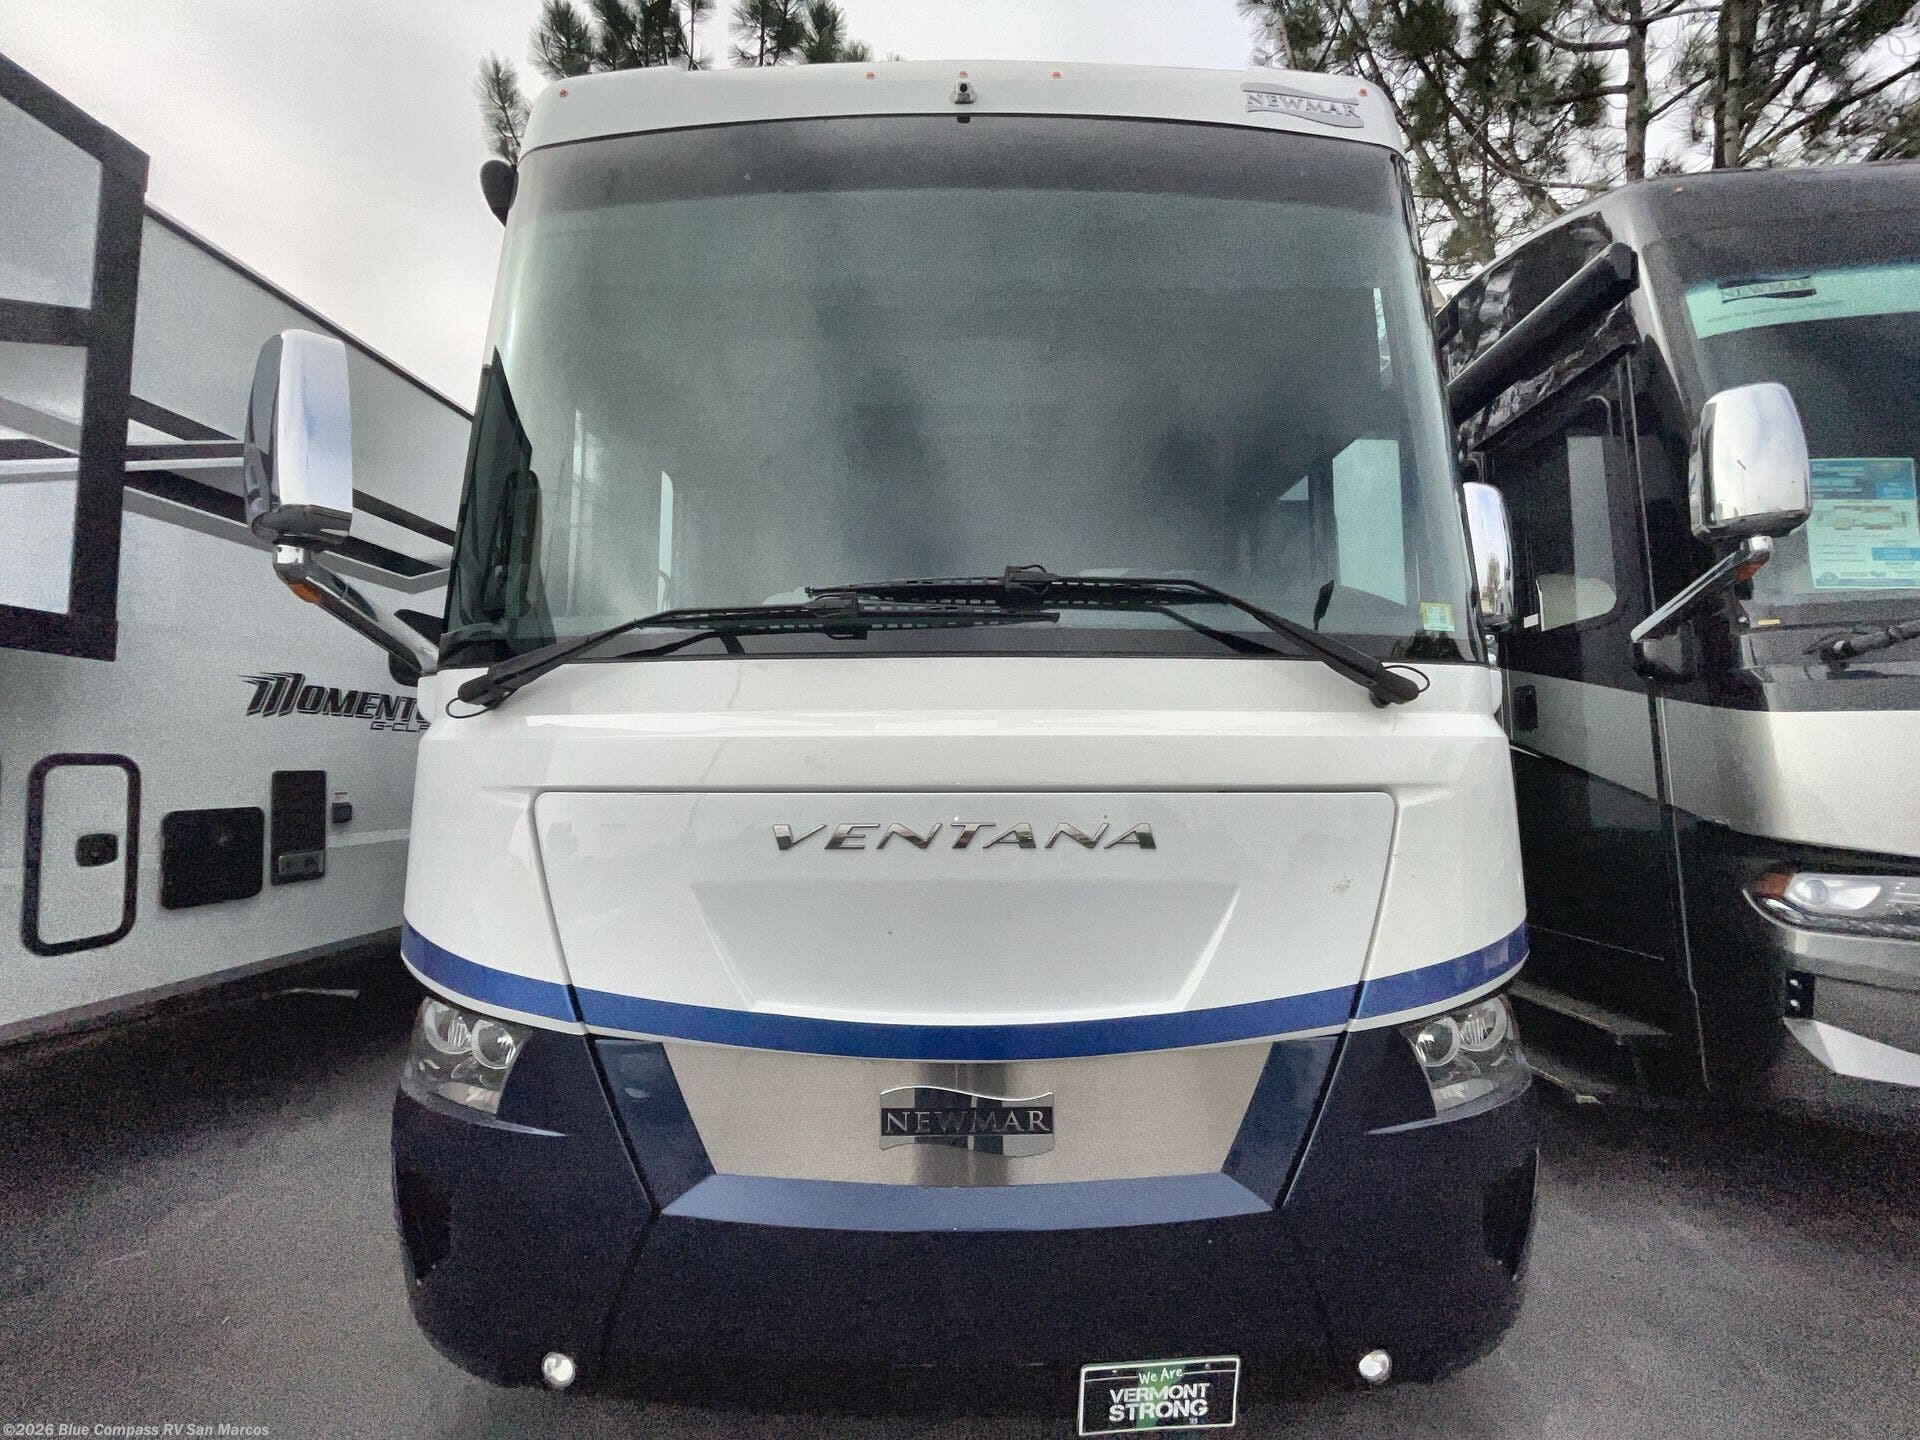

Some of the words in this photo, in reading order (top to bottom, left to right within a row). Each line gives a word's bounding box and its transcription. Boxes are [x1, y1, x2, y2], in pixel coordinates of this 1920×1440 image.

[1246, 92, 1361, 119] NEWMAR
[772, 821, 1158, 851] VENTANA
[885, 1109, 1051, 1134] NEWMAR
[1138, 1371, 1158, 1385] We
[1160, 1366, 1183, 1382] Are
[1109, 1382, 1210, 1403] VERMONT
[1109, 1398, 1208, 1422] STRONG
